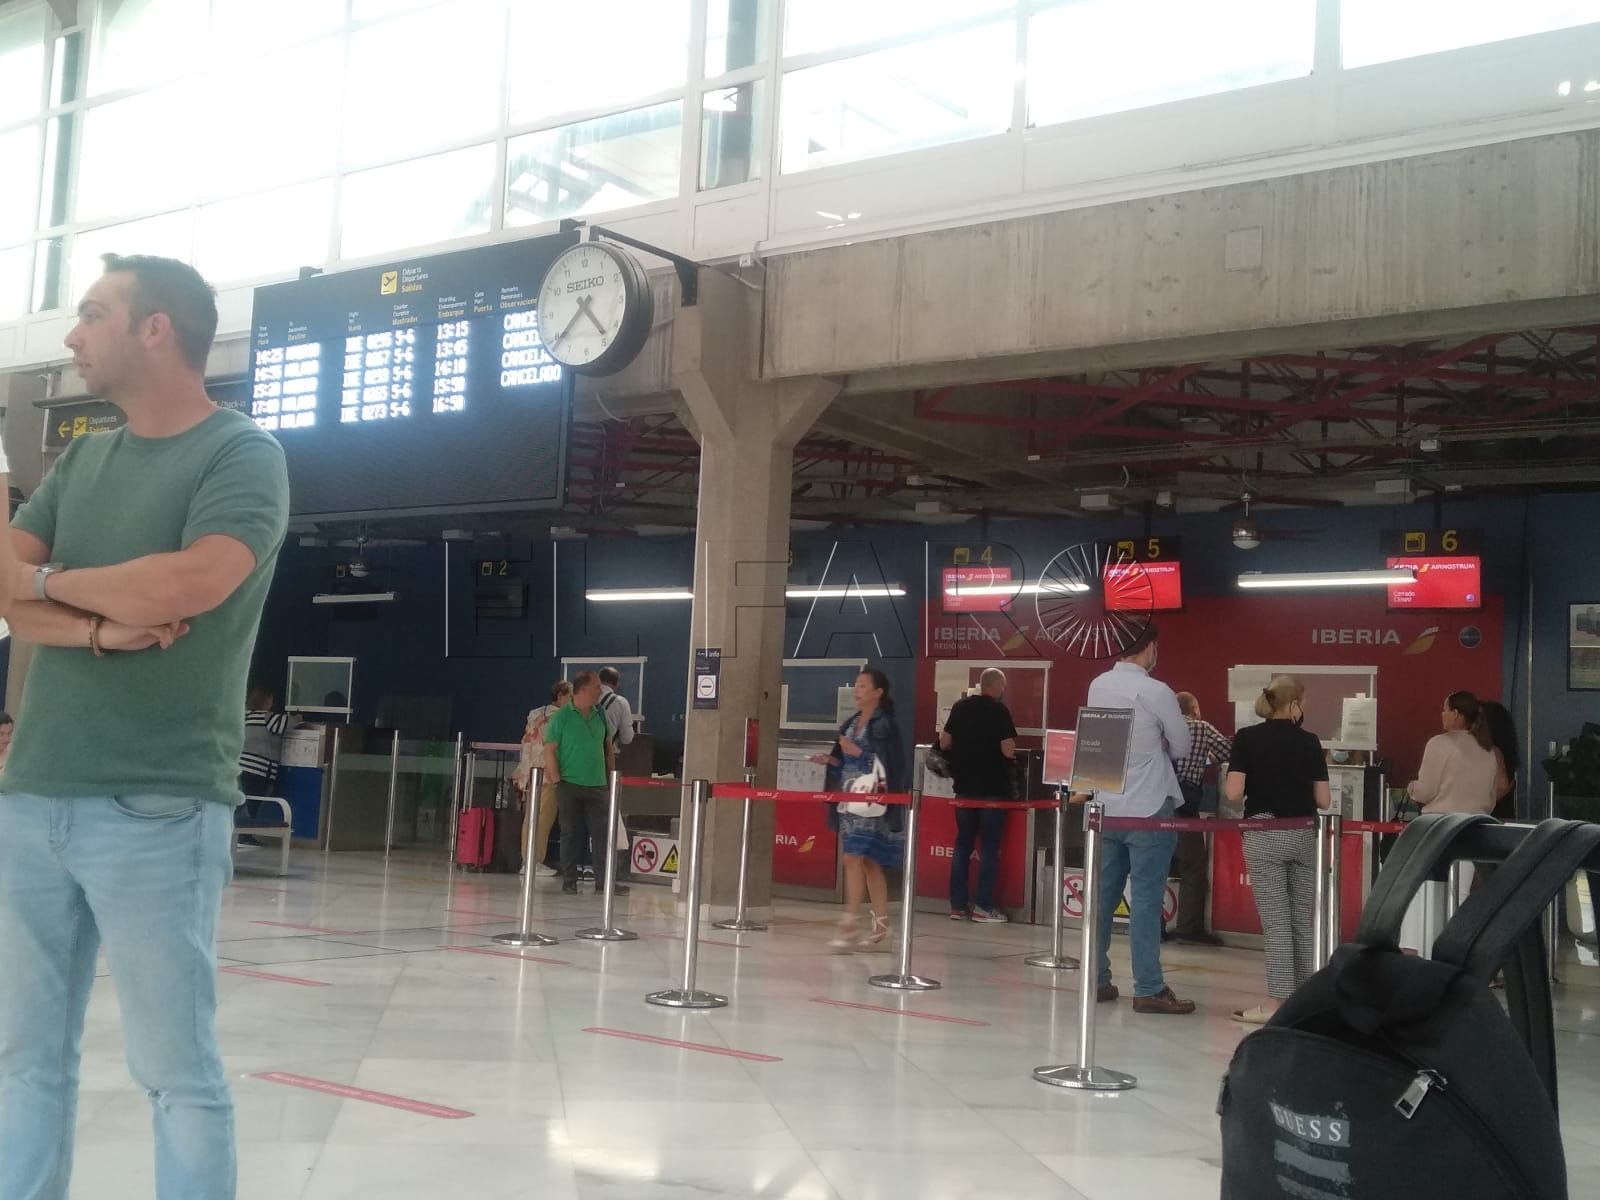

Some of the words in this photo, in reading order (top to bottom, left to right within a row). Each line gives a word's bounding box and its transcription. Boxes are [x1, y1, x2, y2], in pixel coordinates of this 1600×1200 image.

[582, 259, 588, 268] 12
[564, 270, 570, 278] 11
[401, 284, 422, 293] Salidas
[554, 288, 561, 296] 10
[566, 276, 604, 294] SEIKO
[474, 304, 492, 312] Puerta
[394, 328, 415, 346] 5-6
[437, 320, 470, 340] 13:15
[504, 310, 537, 330] CANCE
[394, 346, 414, 364] 5-6
[392, 365, 413, 381] 5-6
[502, 348, 554, 368] CANCELA
[391, 382, 412, 400] 5-6
[501, 364, 562, 387] CANCELADO
[390, 401, 410, 418] 5-6
[1148, 538, 1160, 558] 5
[1442, 530, 1458, 551] 6
[980, 546, 992, 564] 4
[499, 560, 508, 576] 2
[934, 628, 1001, 640] IBERIA
[1312, 628, 1401, 644] IBERIA
[934, 642, 973, 650] REGIONAL
[776, 835, 797, 846] RIA
[931, 845, 980, 860] IBEA
[1273, 1104, 1342, 1142] GUESS
